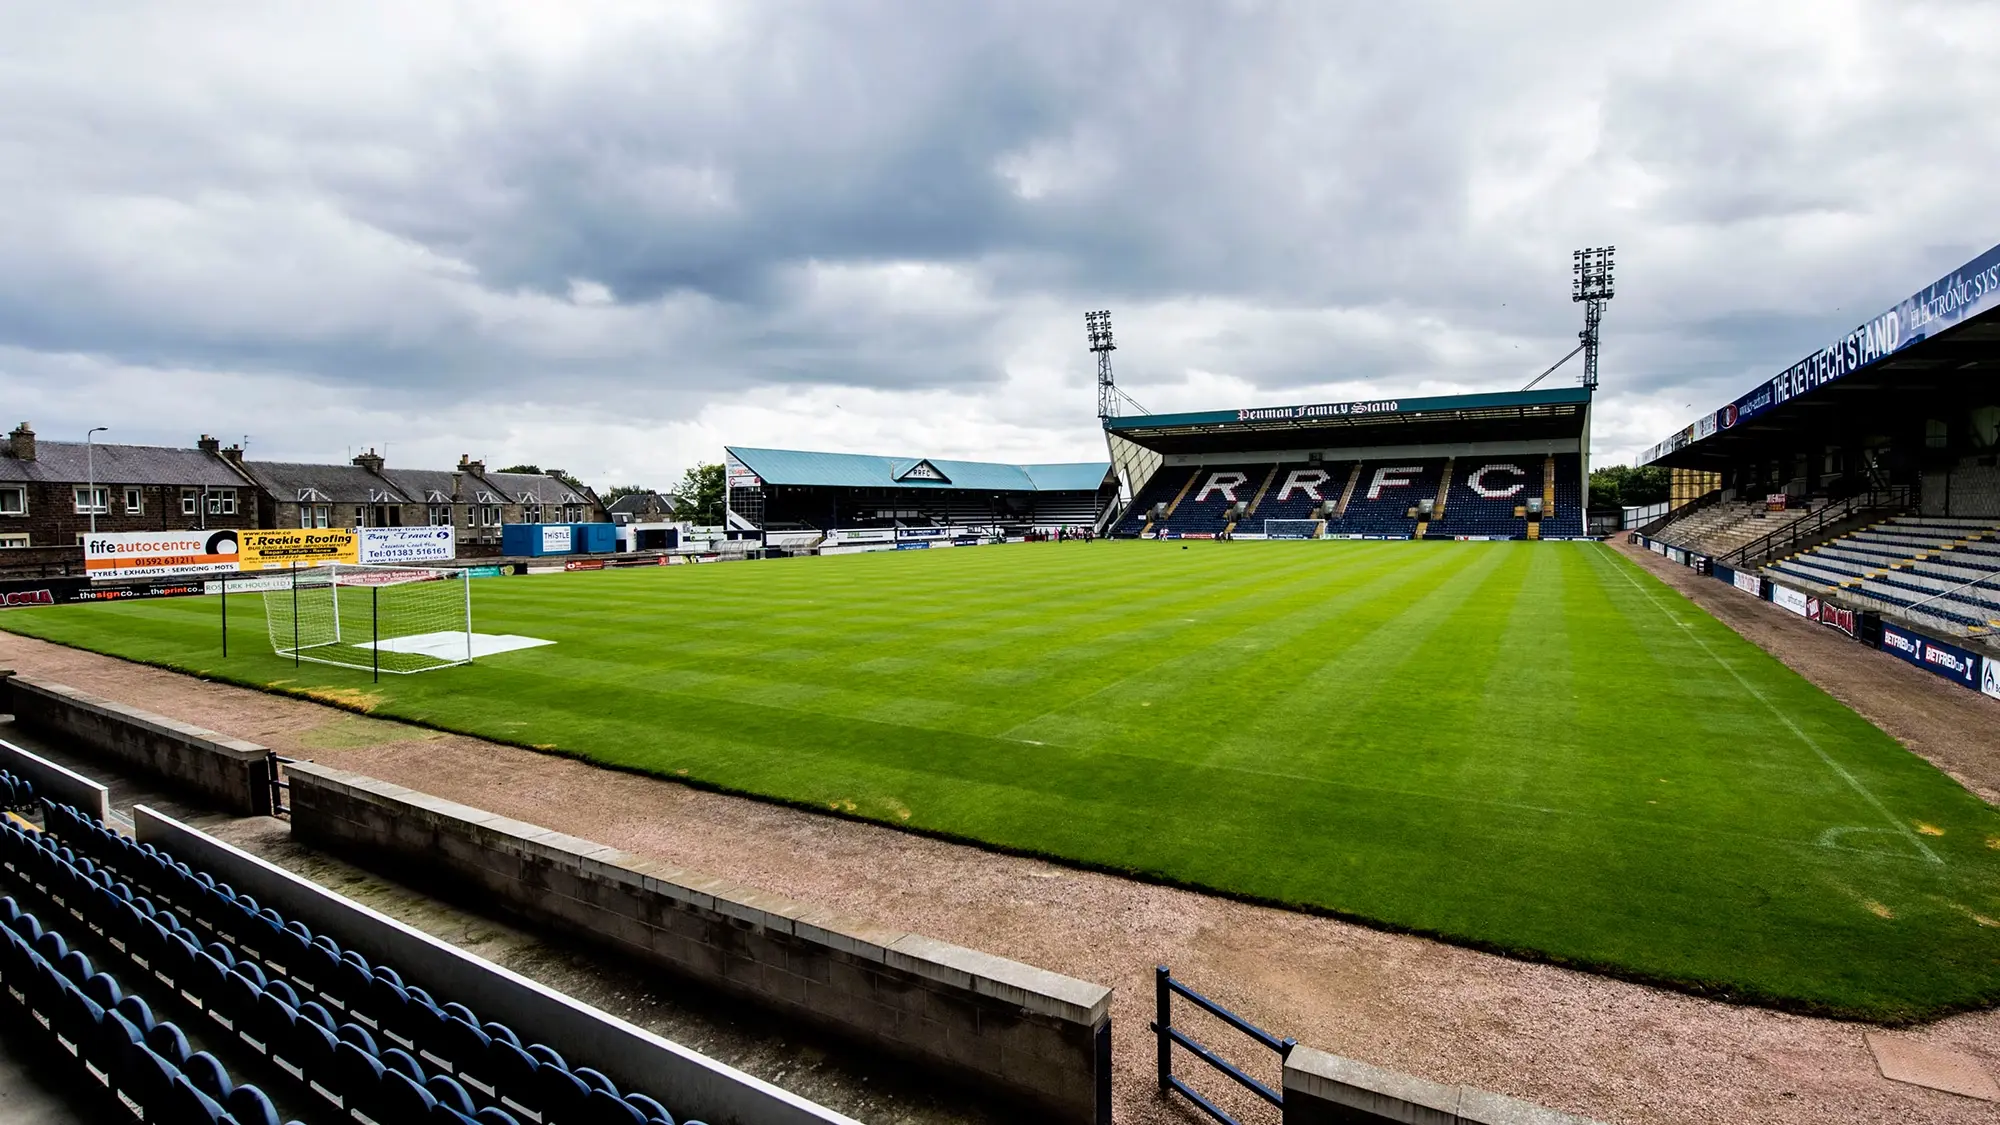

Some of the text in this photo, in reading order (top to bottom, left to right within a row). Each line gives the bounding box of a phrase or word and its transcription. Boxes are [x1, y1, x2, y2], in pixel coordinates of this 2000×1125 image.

[1911, 279, 1972, 330] ELECTRONIC
[1773, 311, 1899, 405] THE KEY-TECH STAND
[1237, 401, 1398, 422] Penman Family Stand
[244, 534, 352, 546] T.Reekie Roofing
[367, 531, 432, 542] Bay Travel
[89, 540, 201, 554] fifeautocentre
[135, 557, 195, 566] 01592 631211
[124, 568, 165, 576] EXHAUSTS
[171, 565, 209, 573] SERVICING
[206, 580, 244, 590] ROSURK
[6, 589, 54, 606] COLA
[1884, 630, 1909, 652] BETFRED
[1926, 646, 1957, 670] BETFRED
